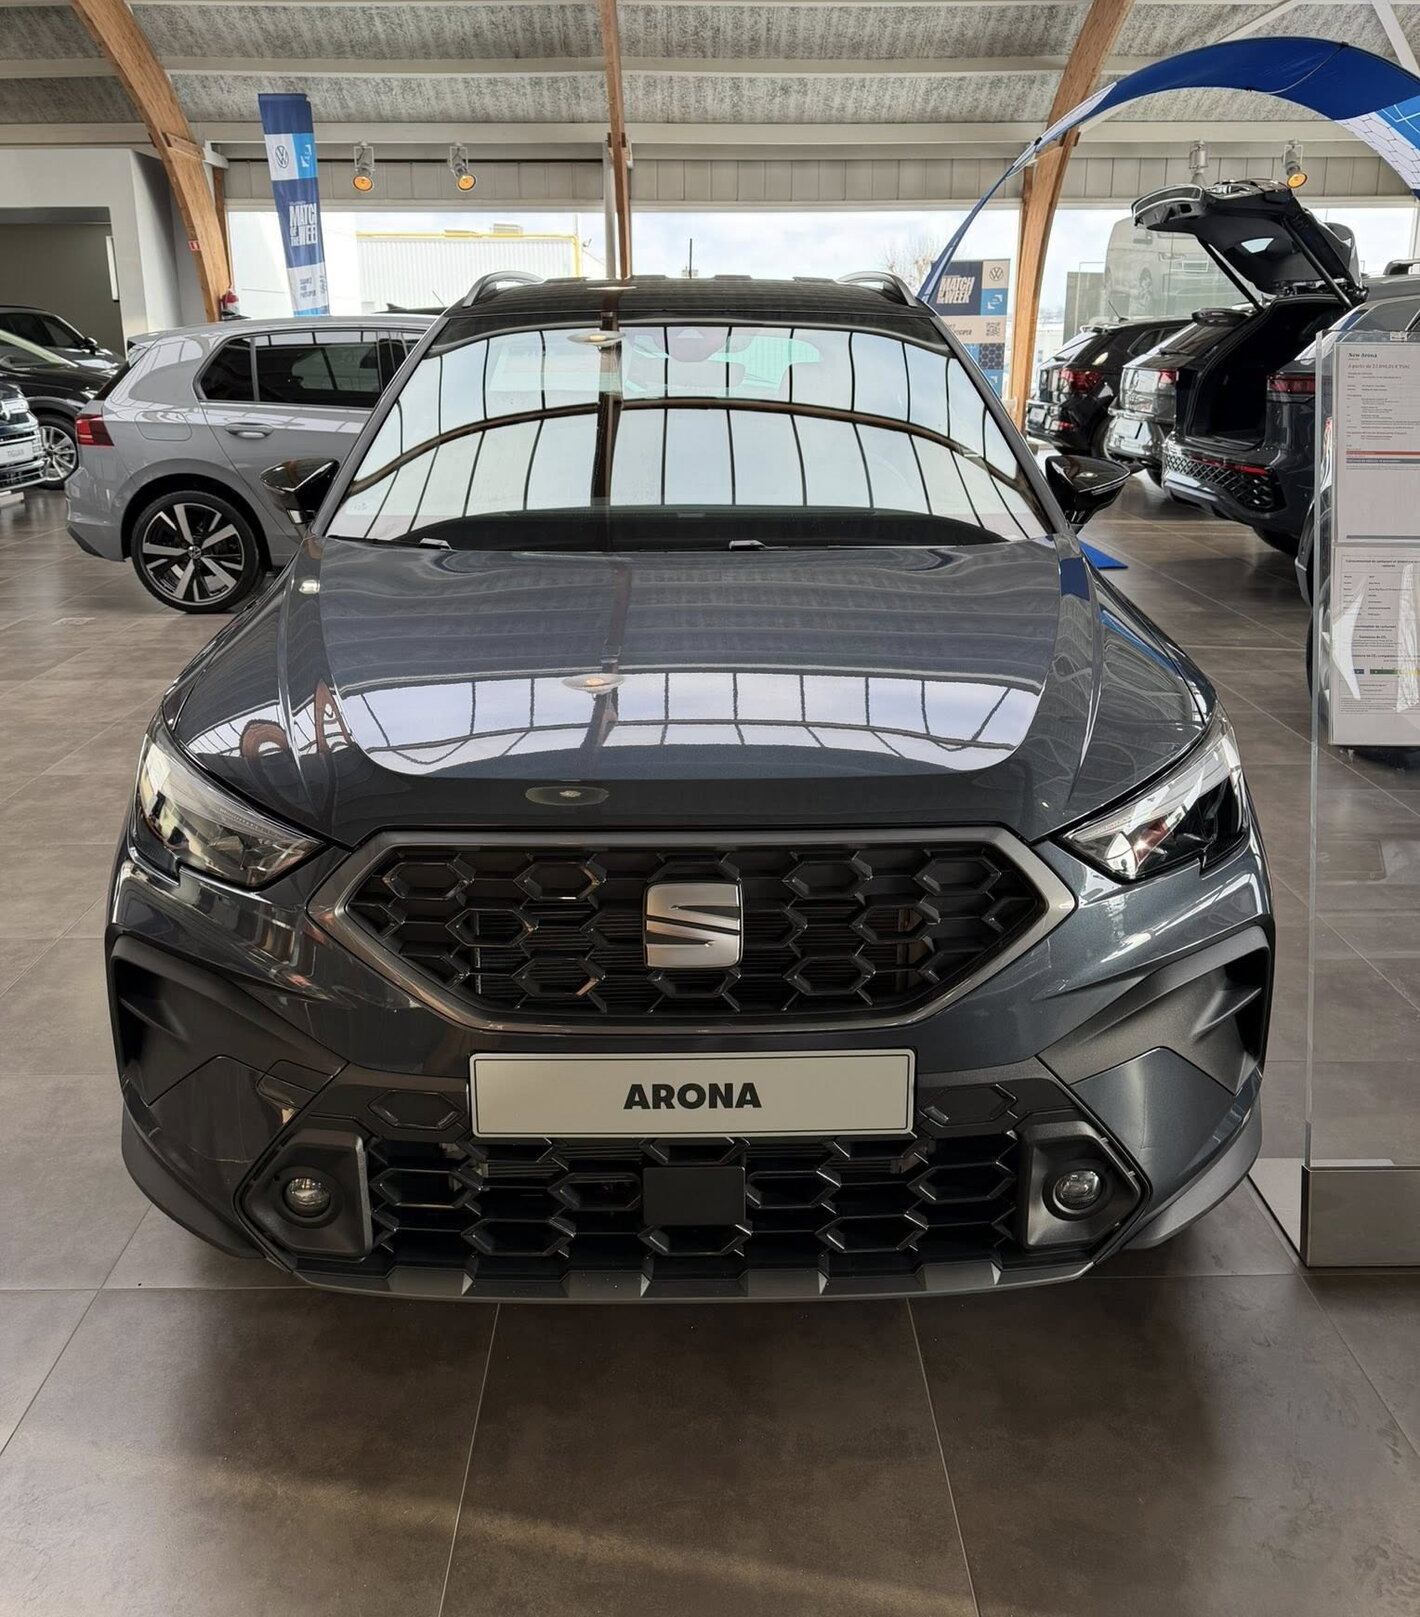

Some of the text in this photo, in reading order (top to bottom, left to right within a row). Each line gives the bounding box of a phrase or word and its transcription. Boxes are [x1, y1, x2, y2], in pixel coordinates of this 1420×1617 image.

[940, 276, 975, 291] MATCH
[944, 290, 970, 304] WEEK
[623, 1082, 762, 1110] ARONA
